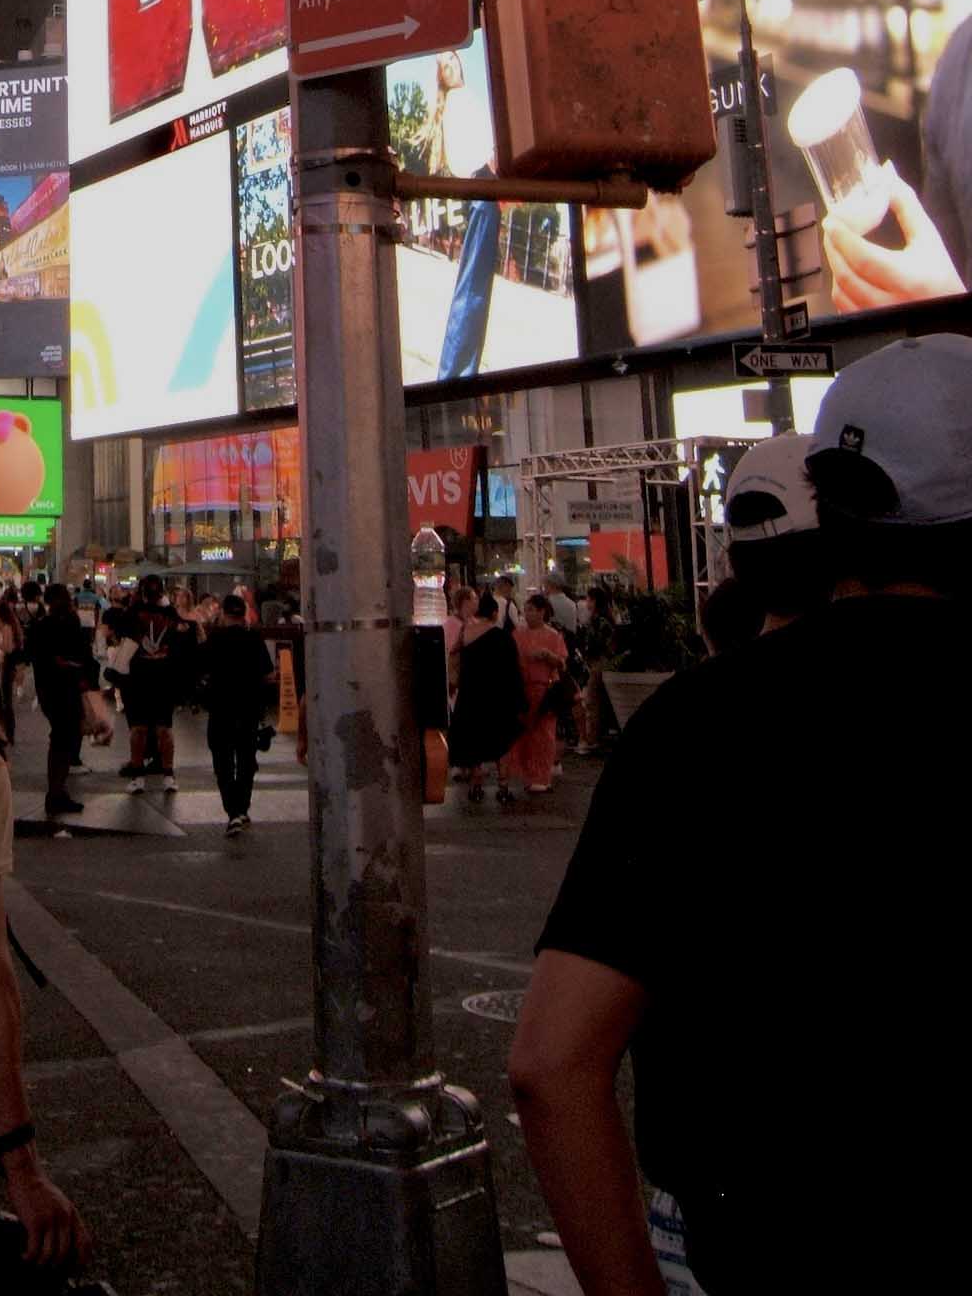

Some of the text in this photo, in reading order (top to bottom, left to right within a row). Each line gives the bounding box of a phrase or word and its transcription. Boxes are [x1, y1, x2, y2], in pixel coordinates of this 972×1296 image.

[709, 73, 770, 114] GUK
[189, 101, 227, 126] MARRIOTT
[190, 116, 225, 141] MARQUIS
[409, 198, 465, 236] LIFE
[251, 238, 296, 280] LOO
[749, 353, 821, 369] ONE WAY
[407, 470, 462, 506] VI'S
